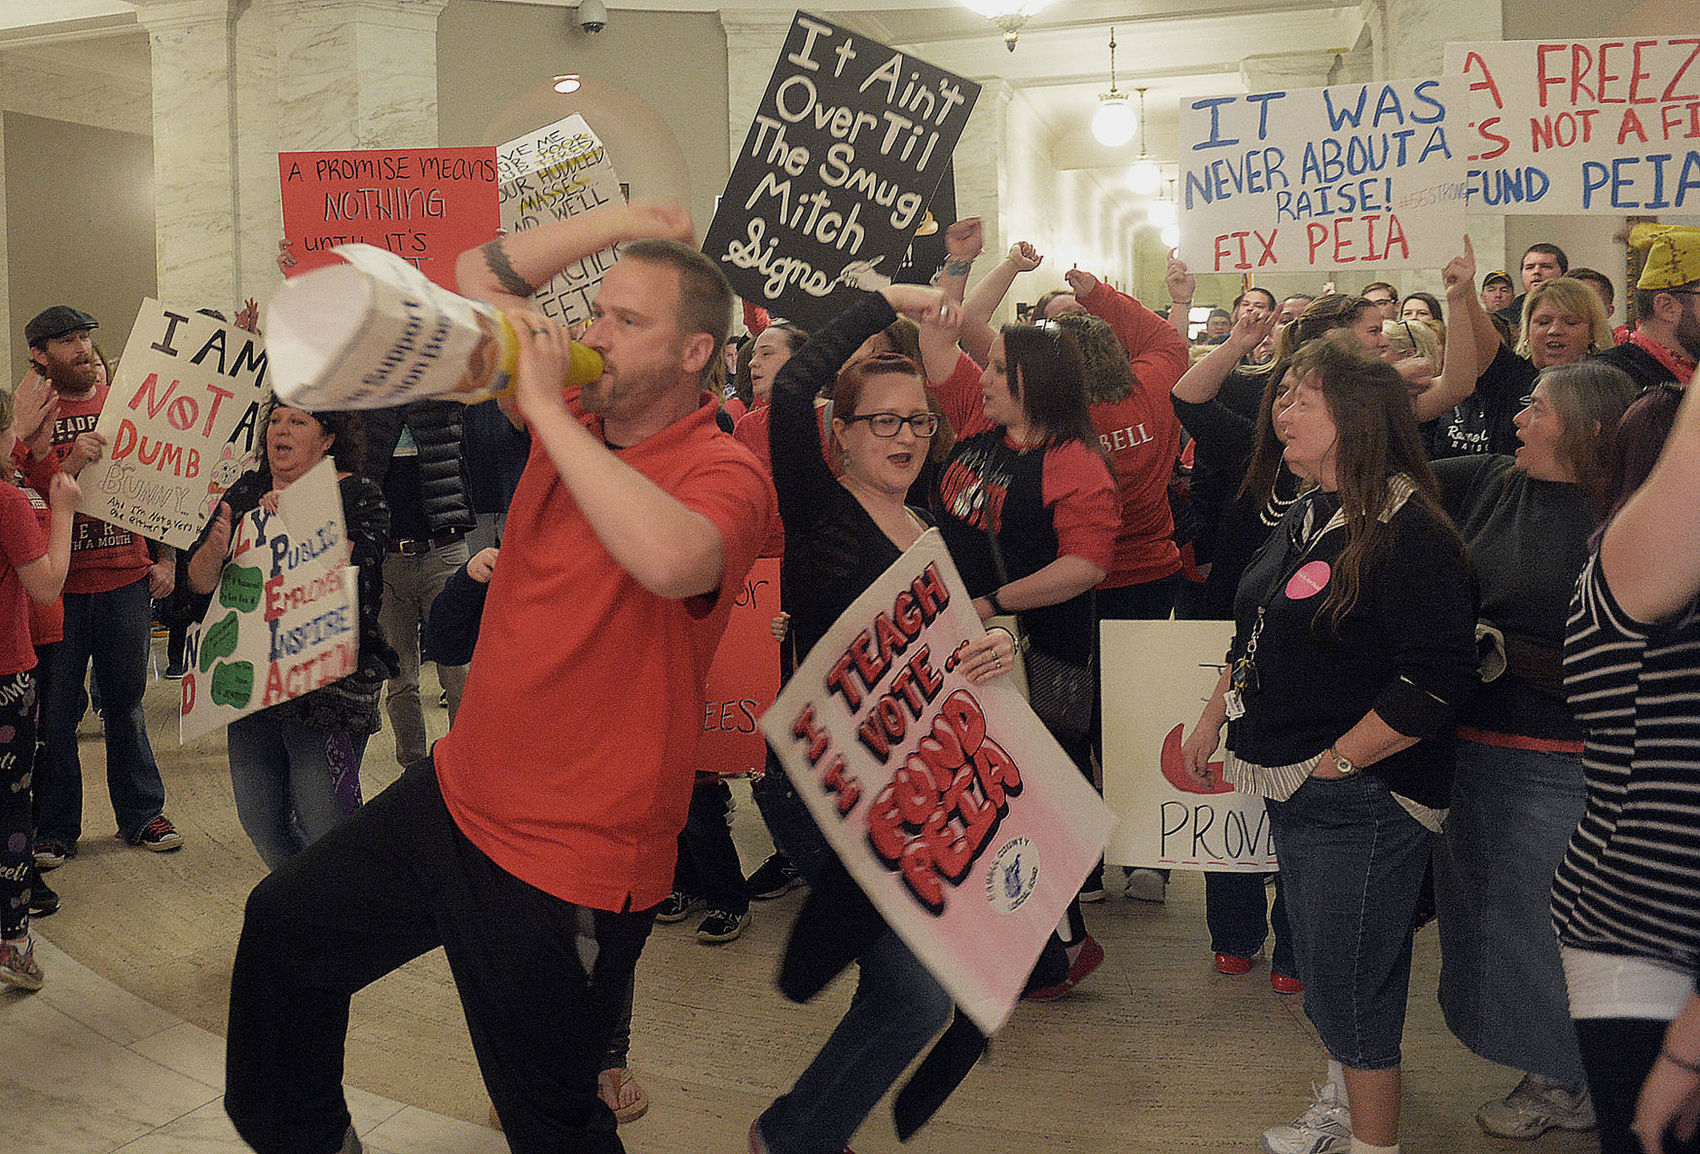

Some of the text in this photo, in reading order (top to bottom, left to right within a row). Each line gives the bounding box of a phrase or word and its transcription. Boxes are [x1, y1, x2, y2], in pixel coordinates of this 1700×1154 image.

[788, 17, 965, 126] It Ain't
[1463, 51, 1503, 110] A
[537, 129, 566, 153] ME
[776, 75, 940, 172] Over Til
[1191, 80, 1446, 152] IT WAS
[1467, 116, 1510, 161] S
[1530, 109, 1600, 153] NOT
[1617, 107, 1649, 145] A
[288, 162, 304, 182] A
[316, 156, 410, 181] PROMISE
[751, 115, 922, 230] The Smug
[1185, 125, 1453, 210] NEVER ABOUT A
[1465, 150, 1700, 210] FUND PEIA
[549, 188, 610, 221] WE'LL
[745, 171, 865, 255] Mitch
[1276, 177, 1393, 225] RAISE!
[385, 228, 428, 252] IT'S
[721, 217, 842, 300] Signs
[1214, 213, 1411, 272] FIX PEIA
[151, 311, 269, 389] I AM
[55, 416, 97, 434] EADP
[127, 372, 260, 453] NOT A
[1098, 421, 1155, 453] BELL
[111, 418, 201, 478] DUMB
[270, 520, 338, 579] PUBLIC
[269, 605, 351, 663] INSPIRE
[826, 560, 951, 715] TEACH
[703, 698, 760, 735] EES
[901, 734, 1024, 918] PEIA
